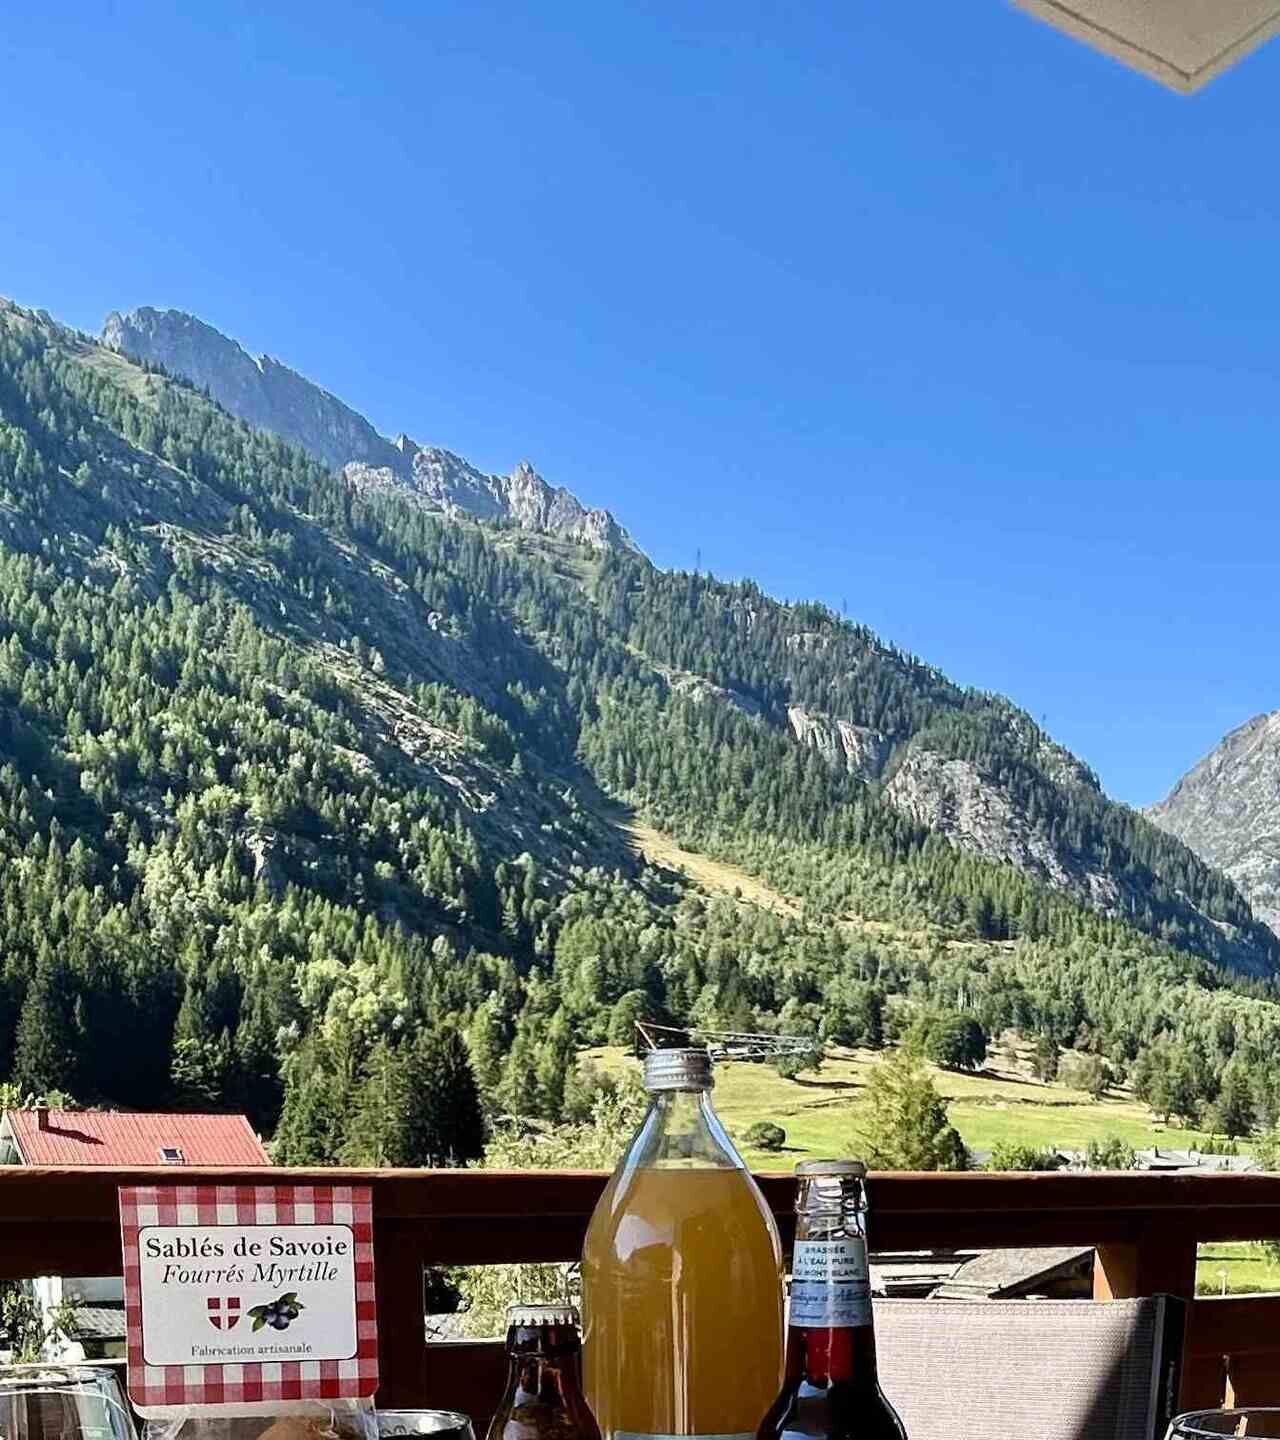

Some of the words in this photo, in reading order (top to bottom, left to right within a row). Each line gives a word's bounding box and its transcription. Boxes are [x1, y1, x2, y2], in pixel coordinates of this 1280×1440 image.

[146, 1236, 225, 1258] Sablés
[233, 1236, 262, 1257] de
[269, 1235, 348, 1257] Savoie
[161, 1263, 245, 1284] Fourrés
[251, 1261, 339, 1288] Myrtille
[191, 1344, 256, 1357] Fabrication
[257, 1343, 313, 1356] artisanale
